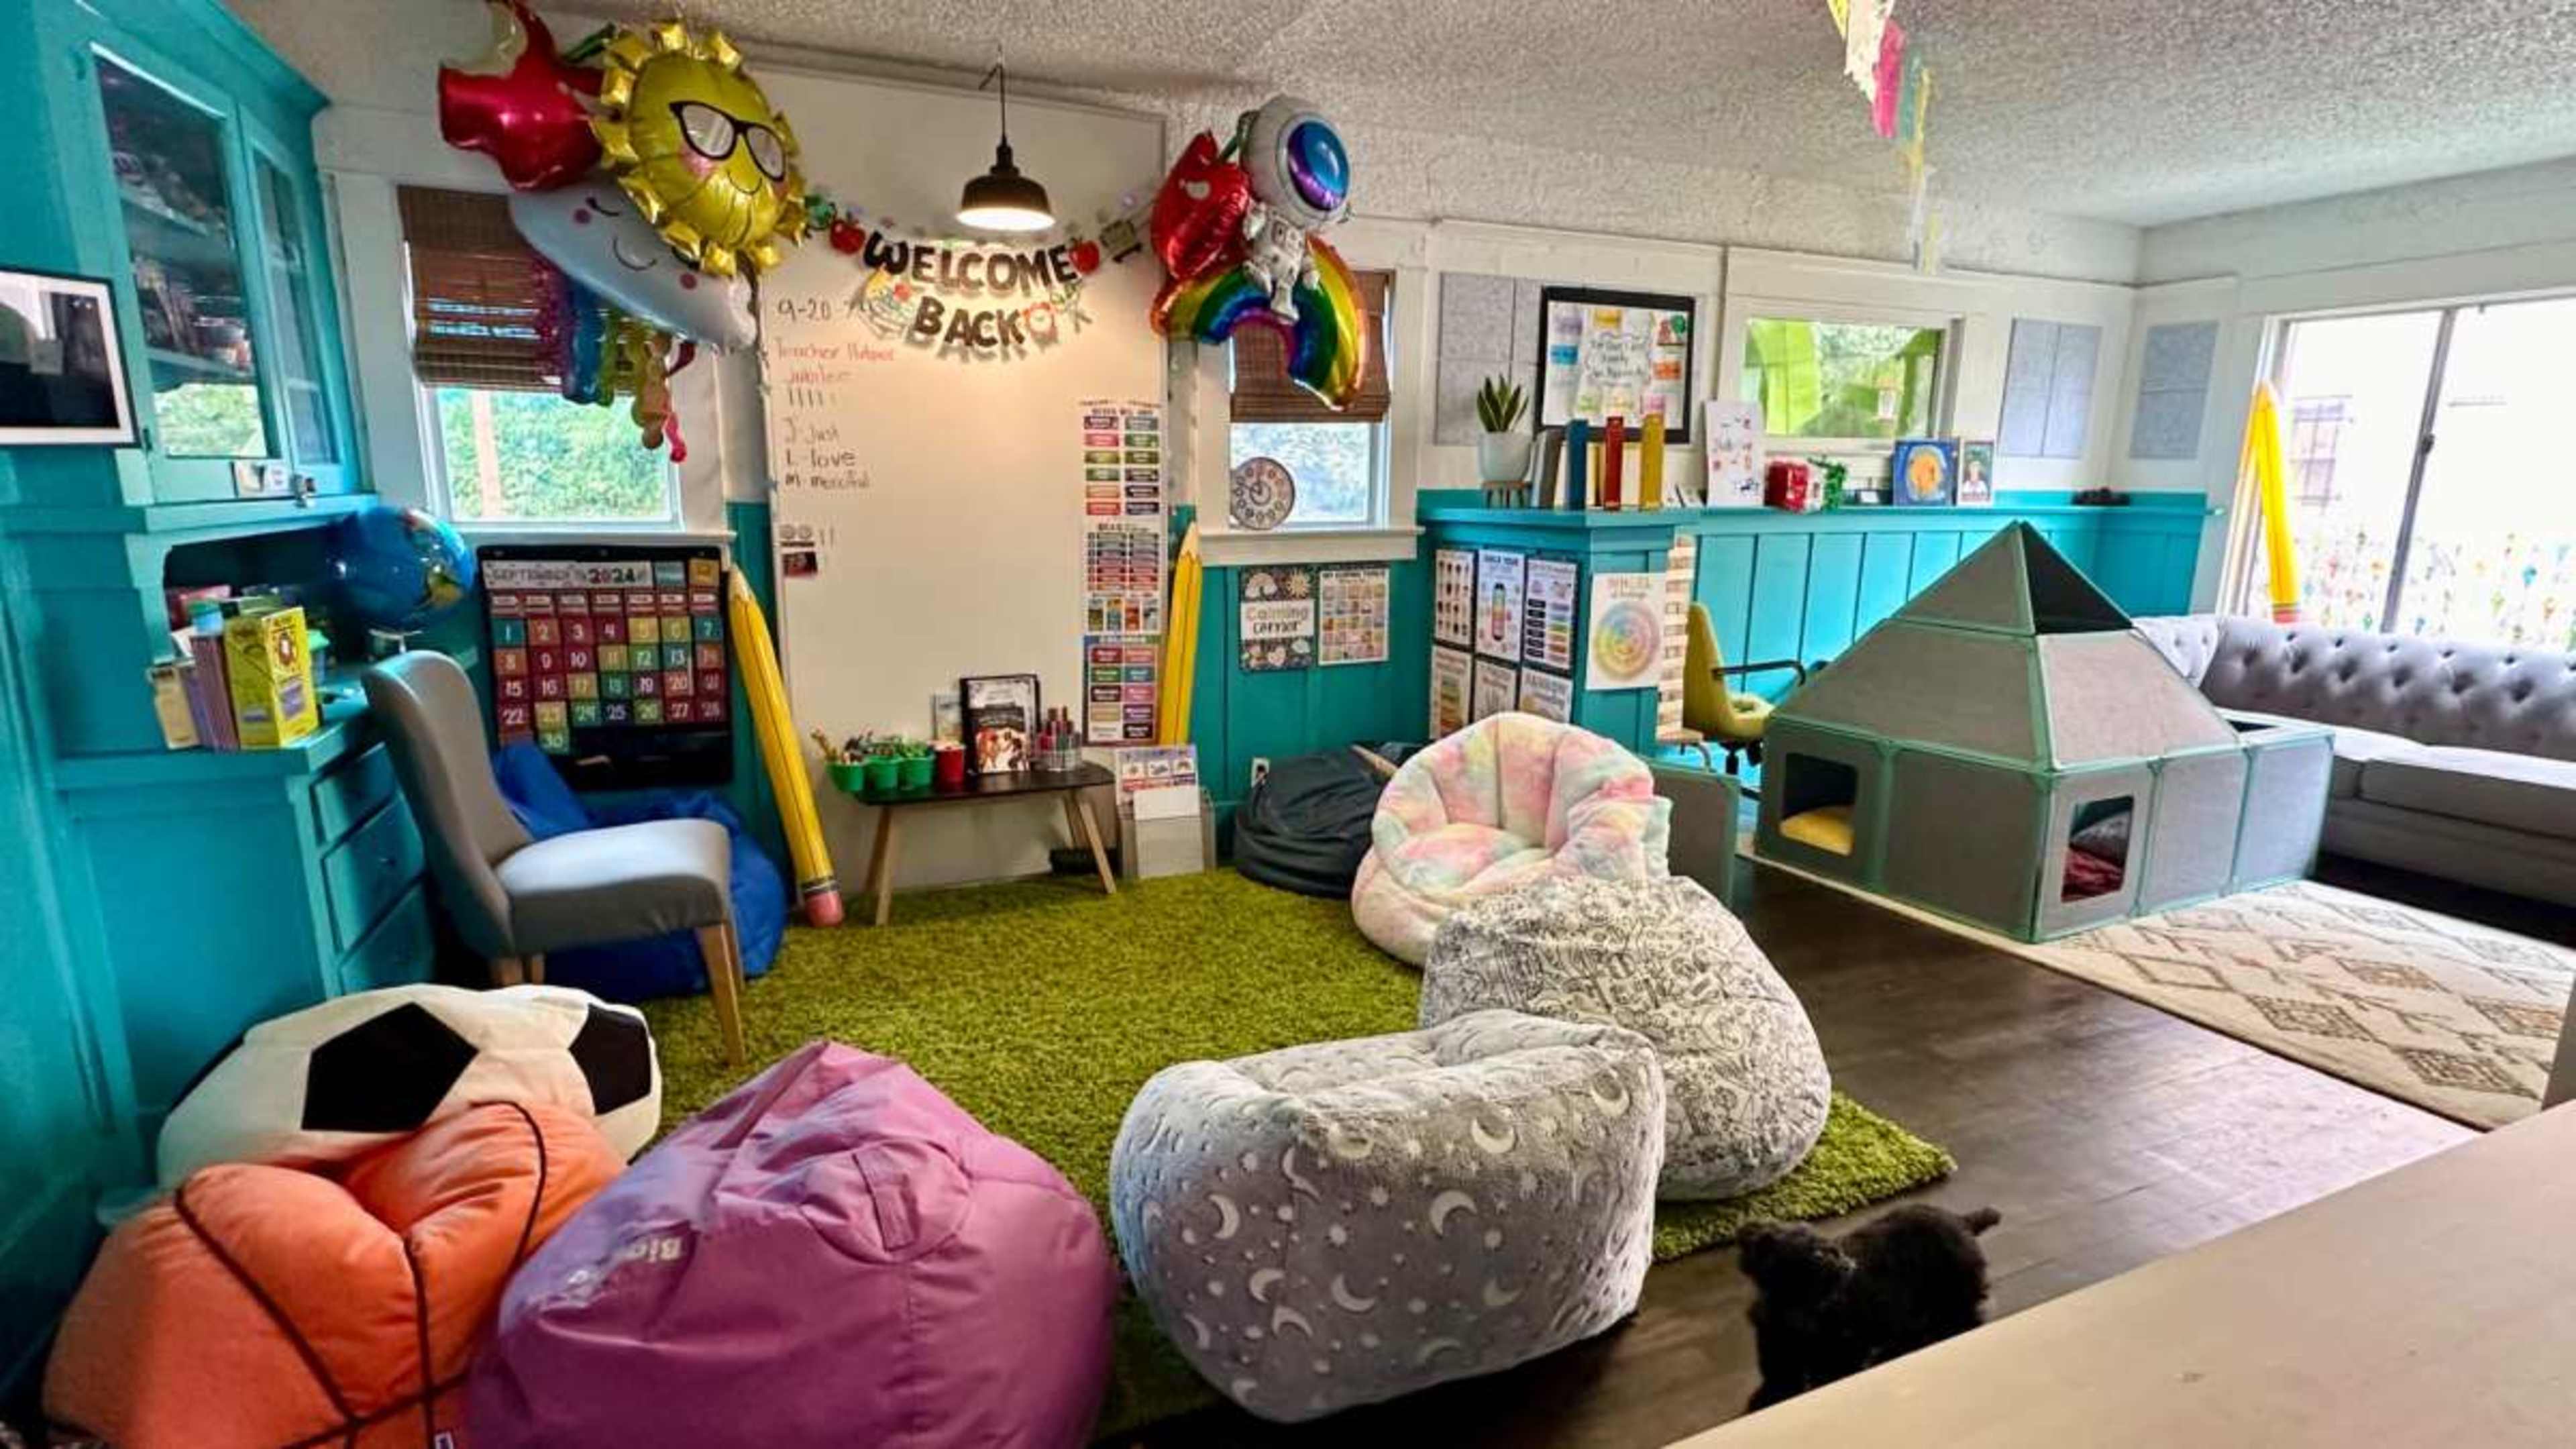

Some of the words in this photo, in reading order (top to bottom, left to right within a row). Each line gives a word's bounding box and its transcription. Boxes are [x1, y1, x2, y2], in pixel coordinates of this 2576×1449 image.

[863, 231, 1079, 298] WELCOME
[916, 296, 1026, 347] BACK
[810, 449, 856, 468] love
[588, 568, 638, 584] 2024
[571, 653, 587, 667] 10
[638, 651, 652, 665] 12
[671, 650, 684, 665] 13
[506, 680, 522, 696] 15
[542, 679, 557, 694] 16
[640, 677, 654, 693] 19
[669, 676, 688, 690] 20
[503, 708, 523, 725] 22
[576, 706, 596, 722] 24
[606, 705, 626, 720] 25
[670, 703, 689, 718] 27
